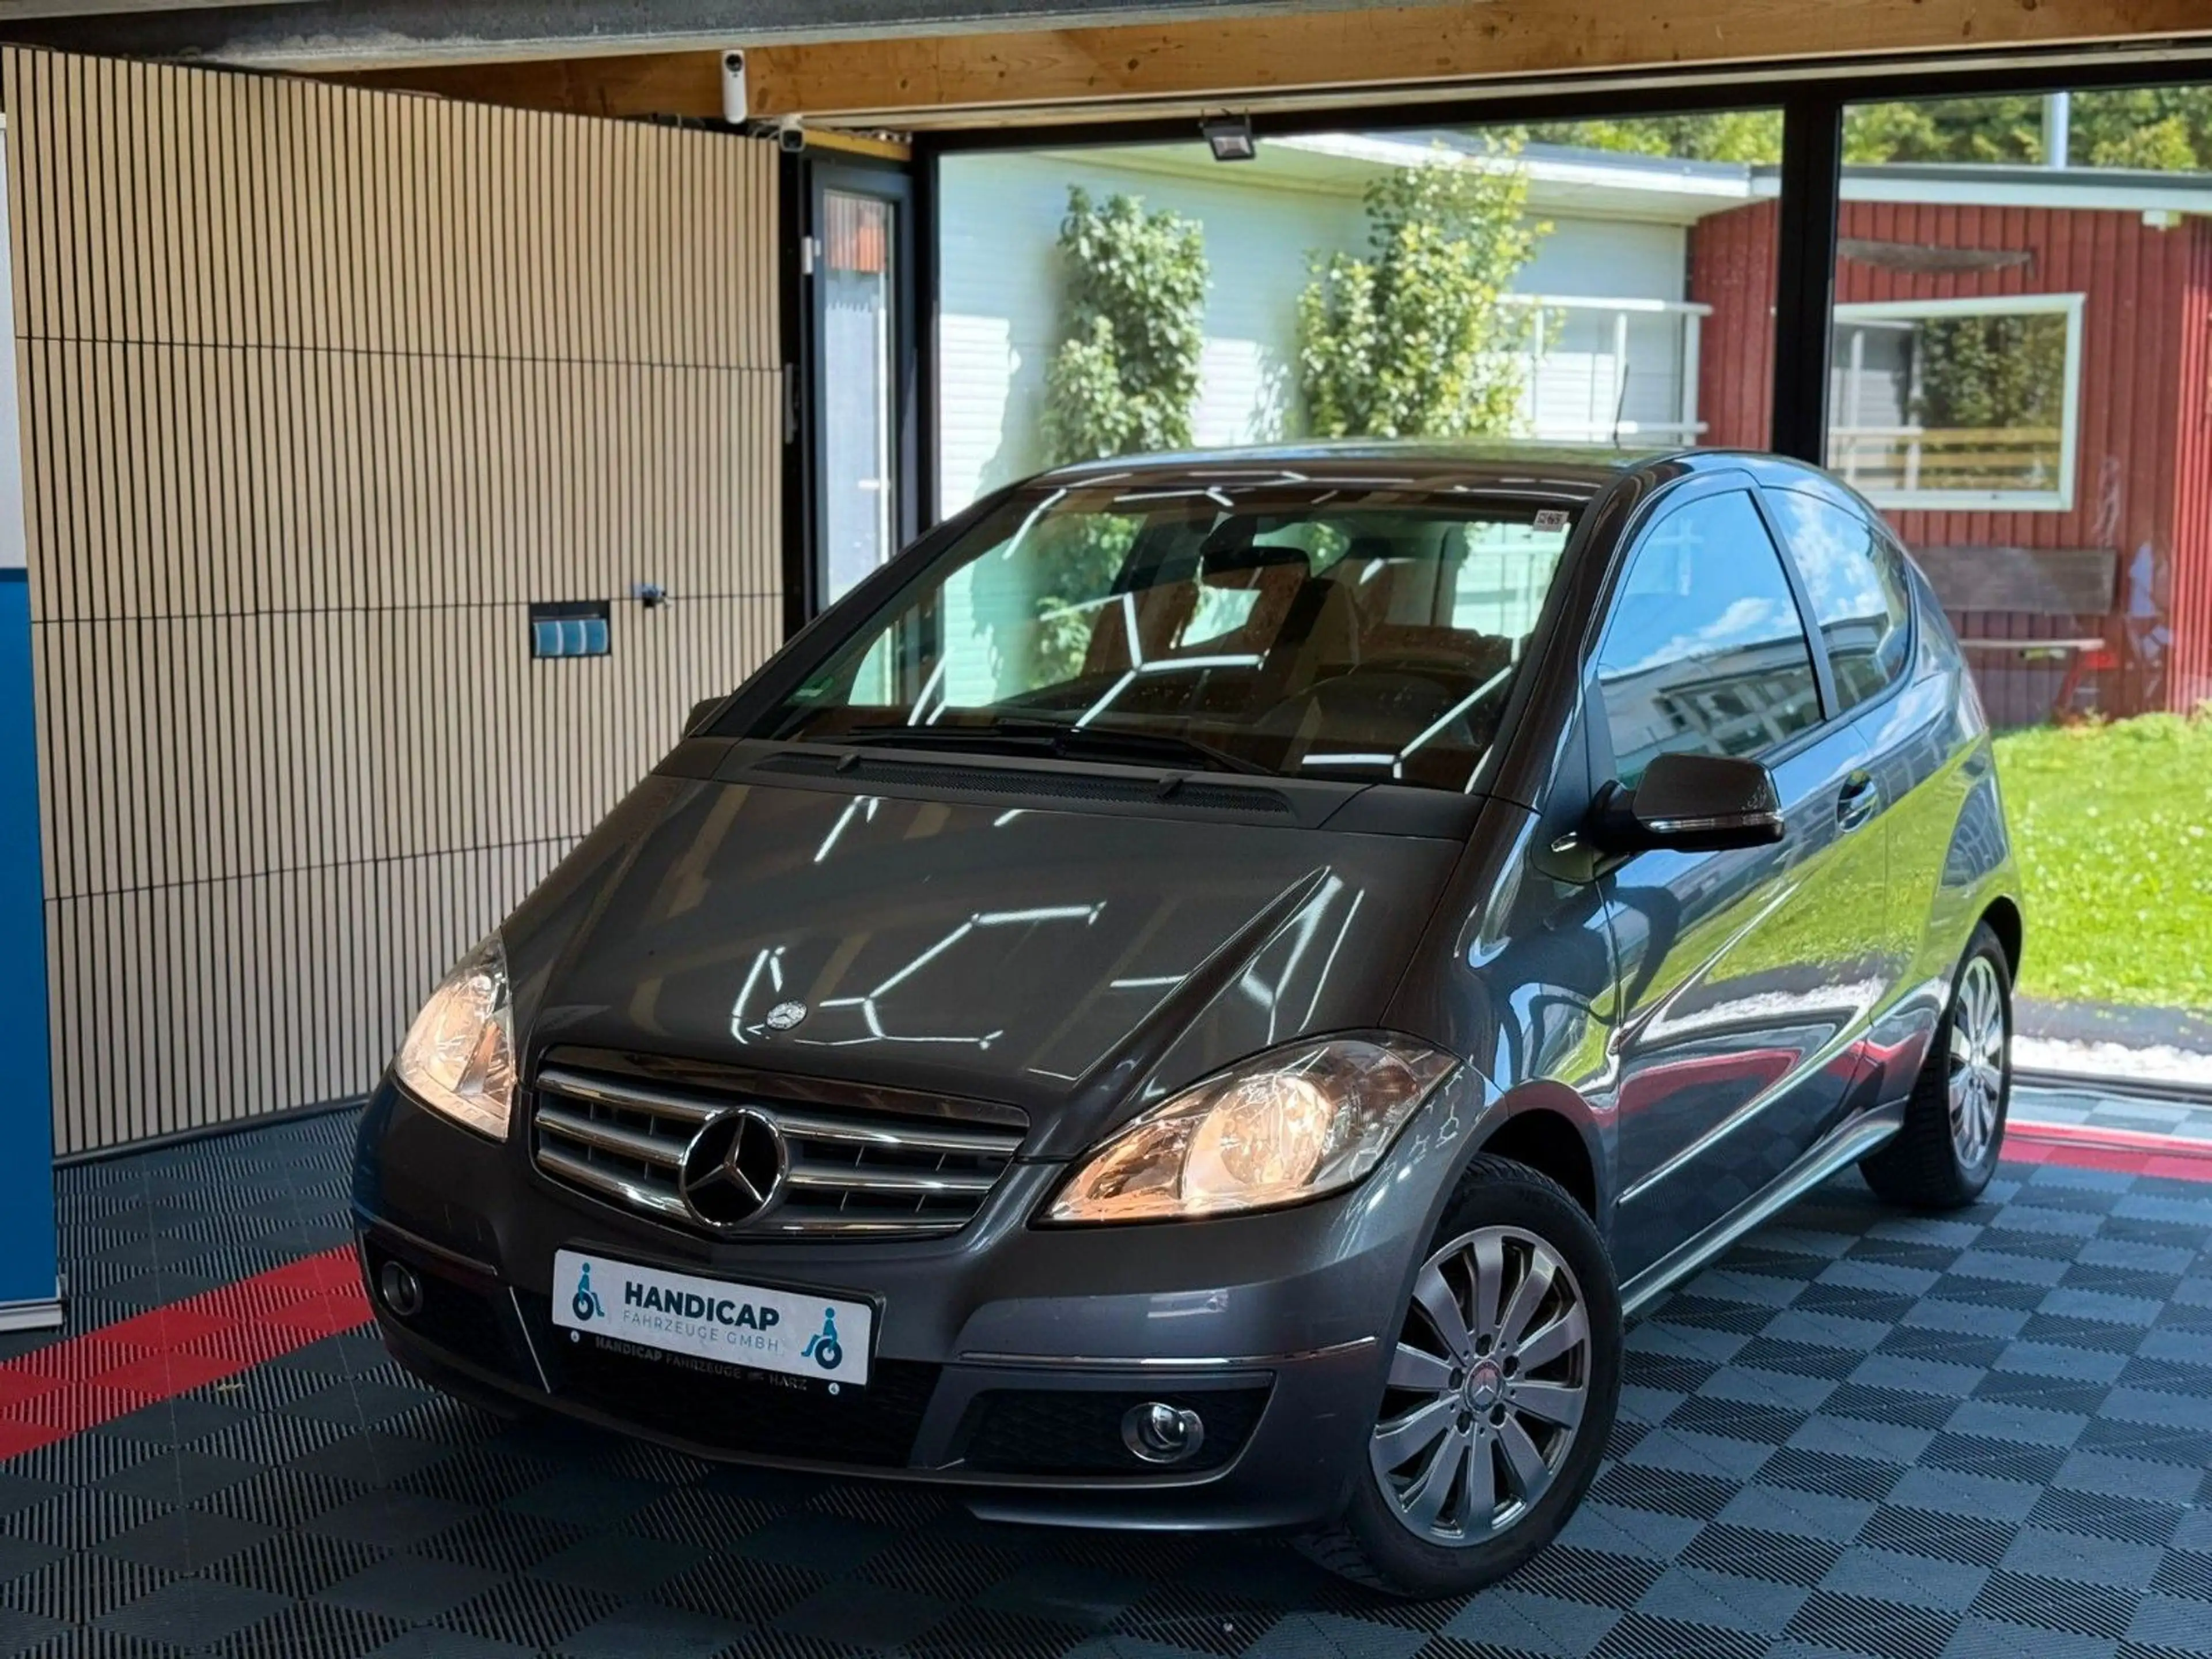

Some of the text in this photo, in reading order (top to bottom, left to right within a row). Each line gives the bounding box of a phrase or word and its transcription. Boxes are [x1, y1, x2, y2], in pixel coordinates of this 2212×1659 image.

[624, 1281, 780, 1331] HANDICAP
[623, 1310, 779, 1352] FAHRZEUGE GMBH
[596, 1335, 662, 1362] HANDICAP
[665, 1355, 742, 1379] FAHRZEUGE
